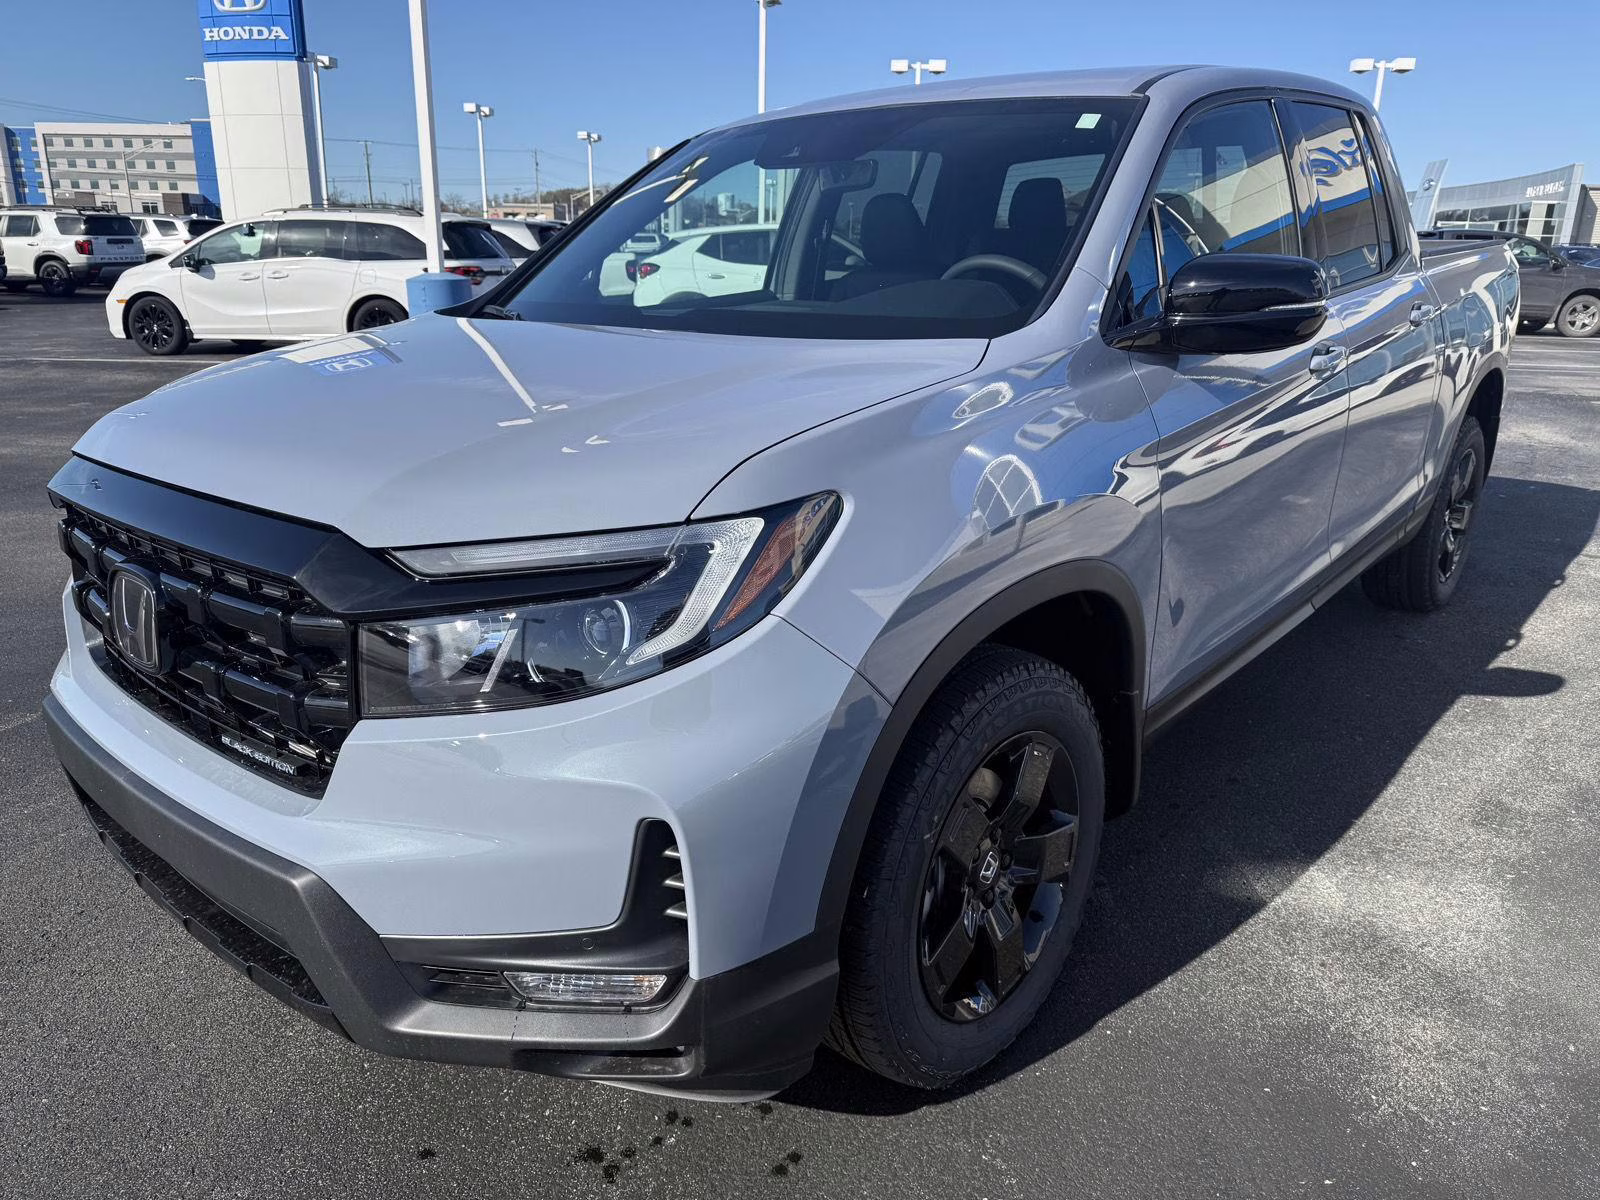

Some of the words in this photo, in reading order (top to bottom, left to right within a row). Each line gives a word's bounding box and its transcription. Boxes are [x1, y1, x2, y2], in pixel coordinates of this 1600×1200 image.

[203, 26, 289, 41] HONDA
[221, 734, 254, 757] BLACK
[254, 751, 295, 775] EDITION
